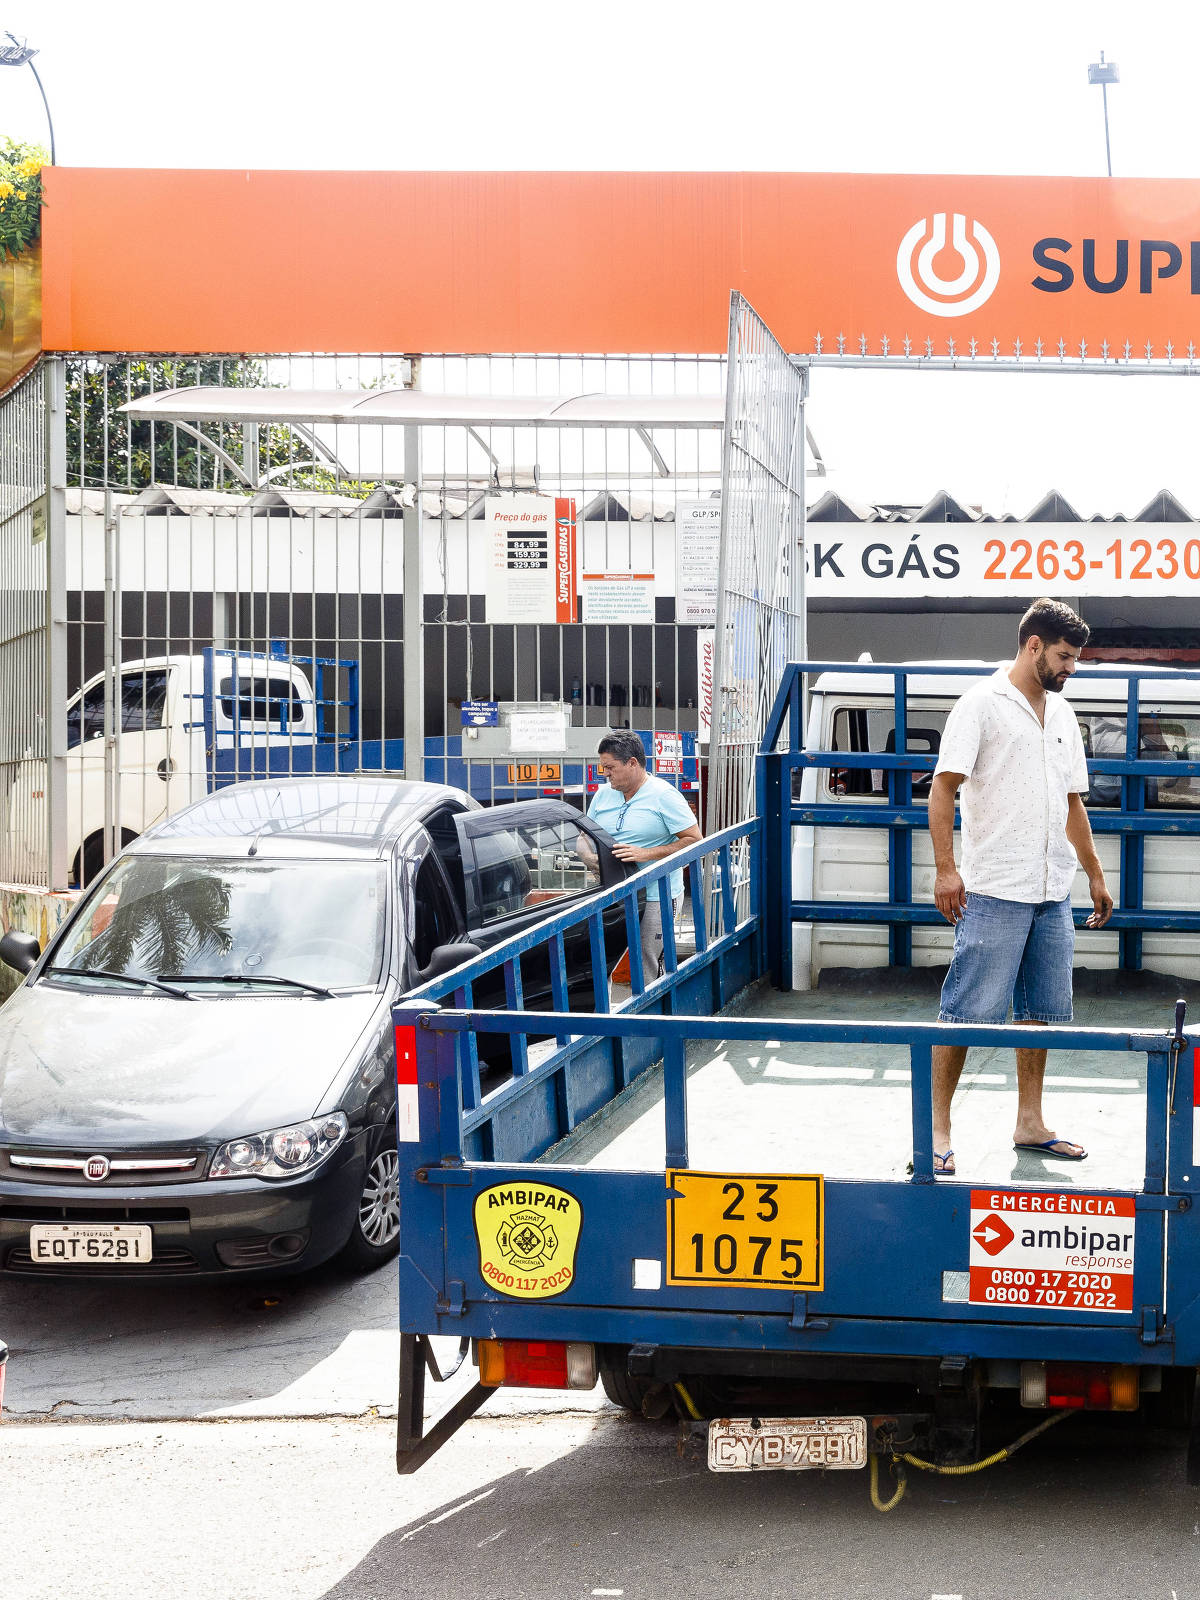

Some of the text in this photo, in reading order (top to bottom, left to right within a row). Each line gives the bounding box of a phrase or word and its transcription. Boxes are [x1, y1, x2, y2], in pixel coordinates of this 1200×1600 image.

[494, 512, 519, 522] Preço
[520, 513, 531, 521] do
[861, 534, 960, 579] GÁS
[89, 1163, 105, 1175] FIAT
[488, 1190, 570, 1214] AMBIPAR
[722, 1182, 779, 1222] 23
[990, 1194, 1116, 1215] EMERGÊNCIA
[1021, 1225, 1133, 1256] ambipar
[691, 1233, 803, 1279] 1075
[1065, 1255, 1133, 1270] response
[483, 1261, 572, 1290] 0800 117 2020
[991, 1269, 1112, 1290] 0800 17 2020
[985, 1286, 1117, 1308] 0800 707 7022
